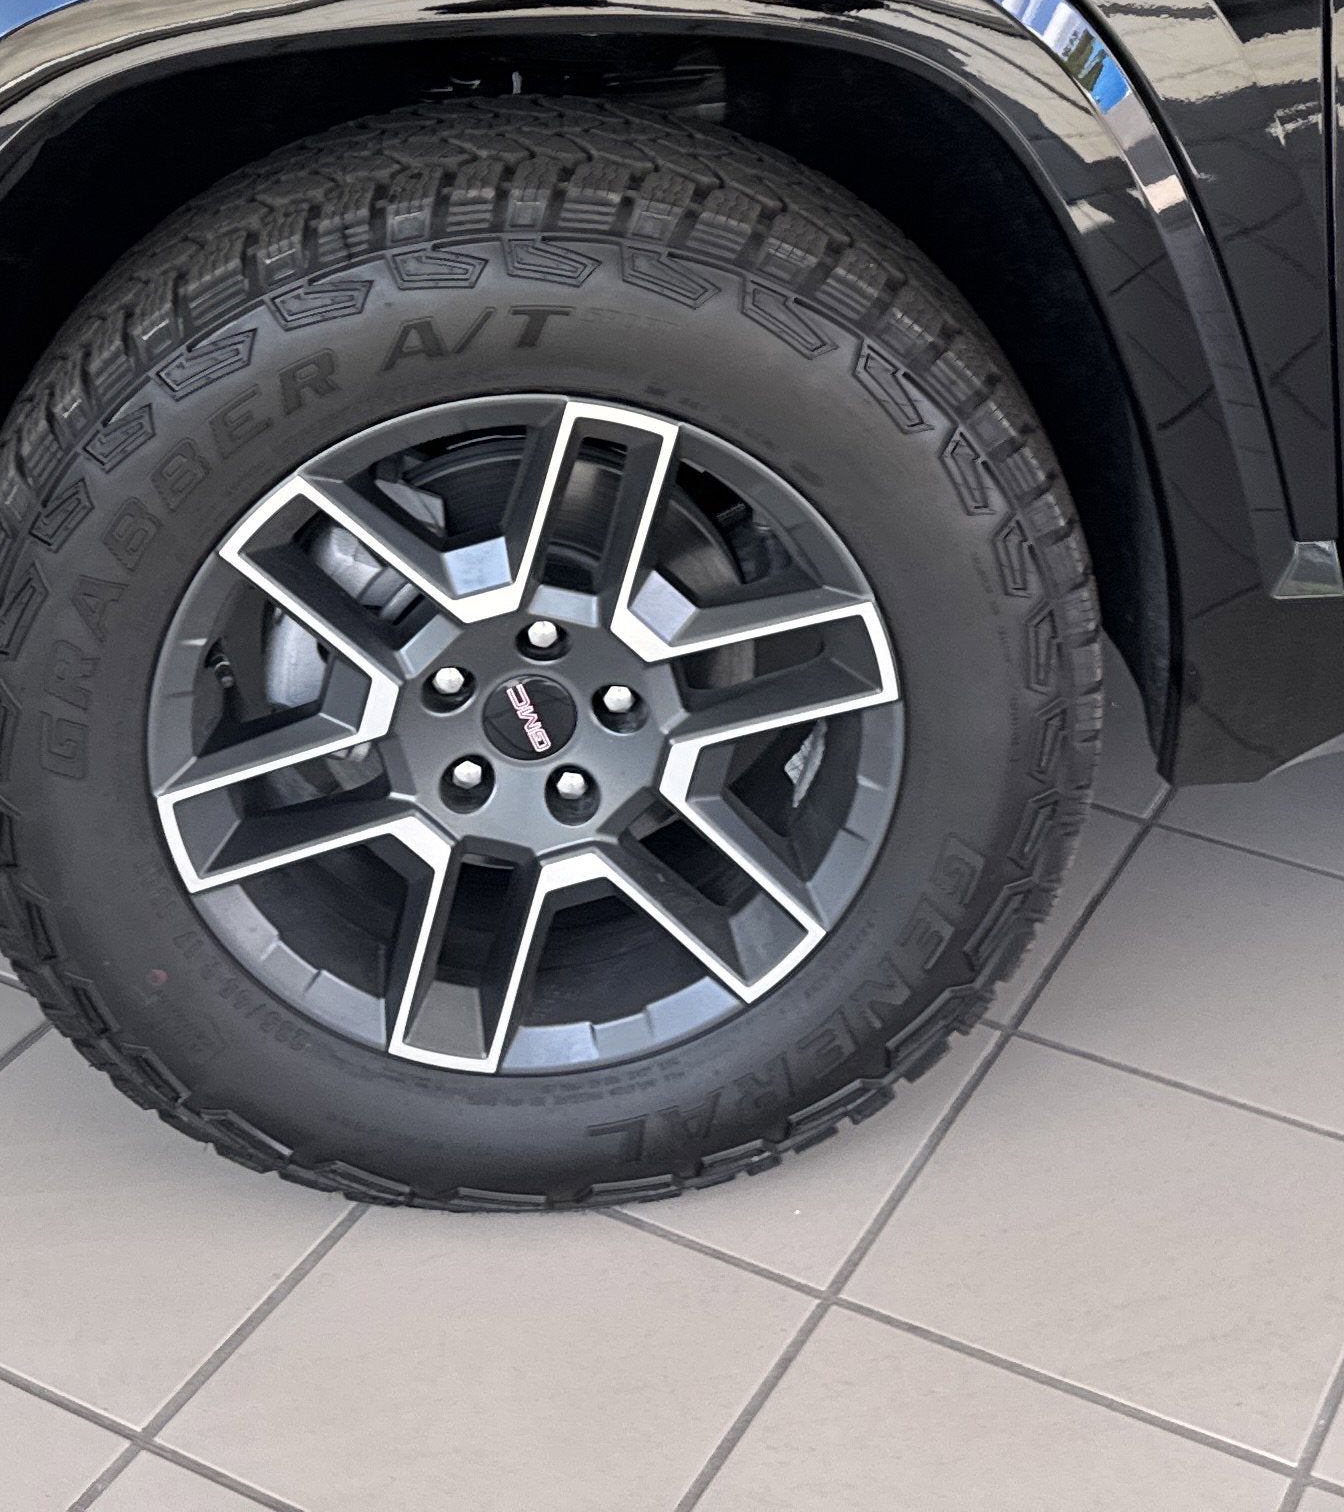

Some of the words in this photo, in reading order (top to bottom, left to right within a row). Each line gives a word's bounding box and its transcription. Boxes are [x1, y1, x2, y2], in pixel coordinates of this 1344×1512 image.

[41, 346, 340, 781] GRABBER
[377, 303, 577, 375] A/T
[506, 683, 552, 753] GMC
[586, 832, 985, 1163] GENERAL
